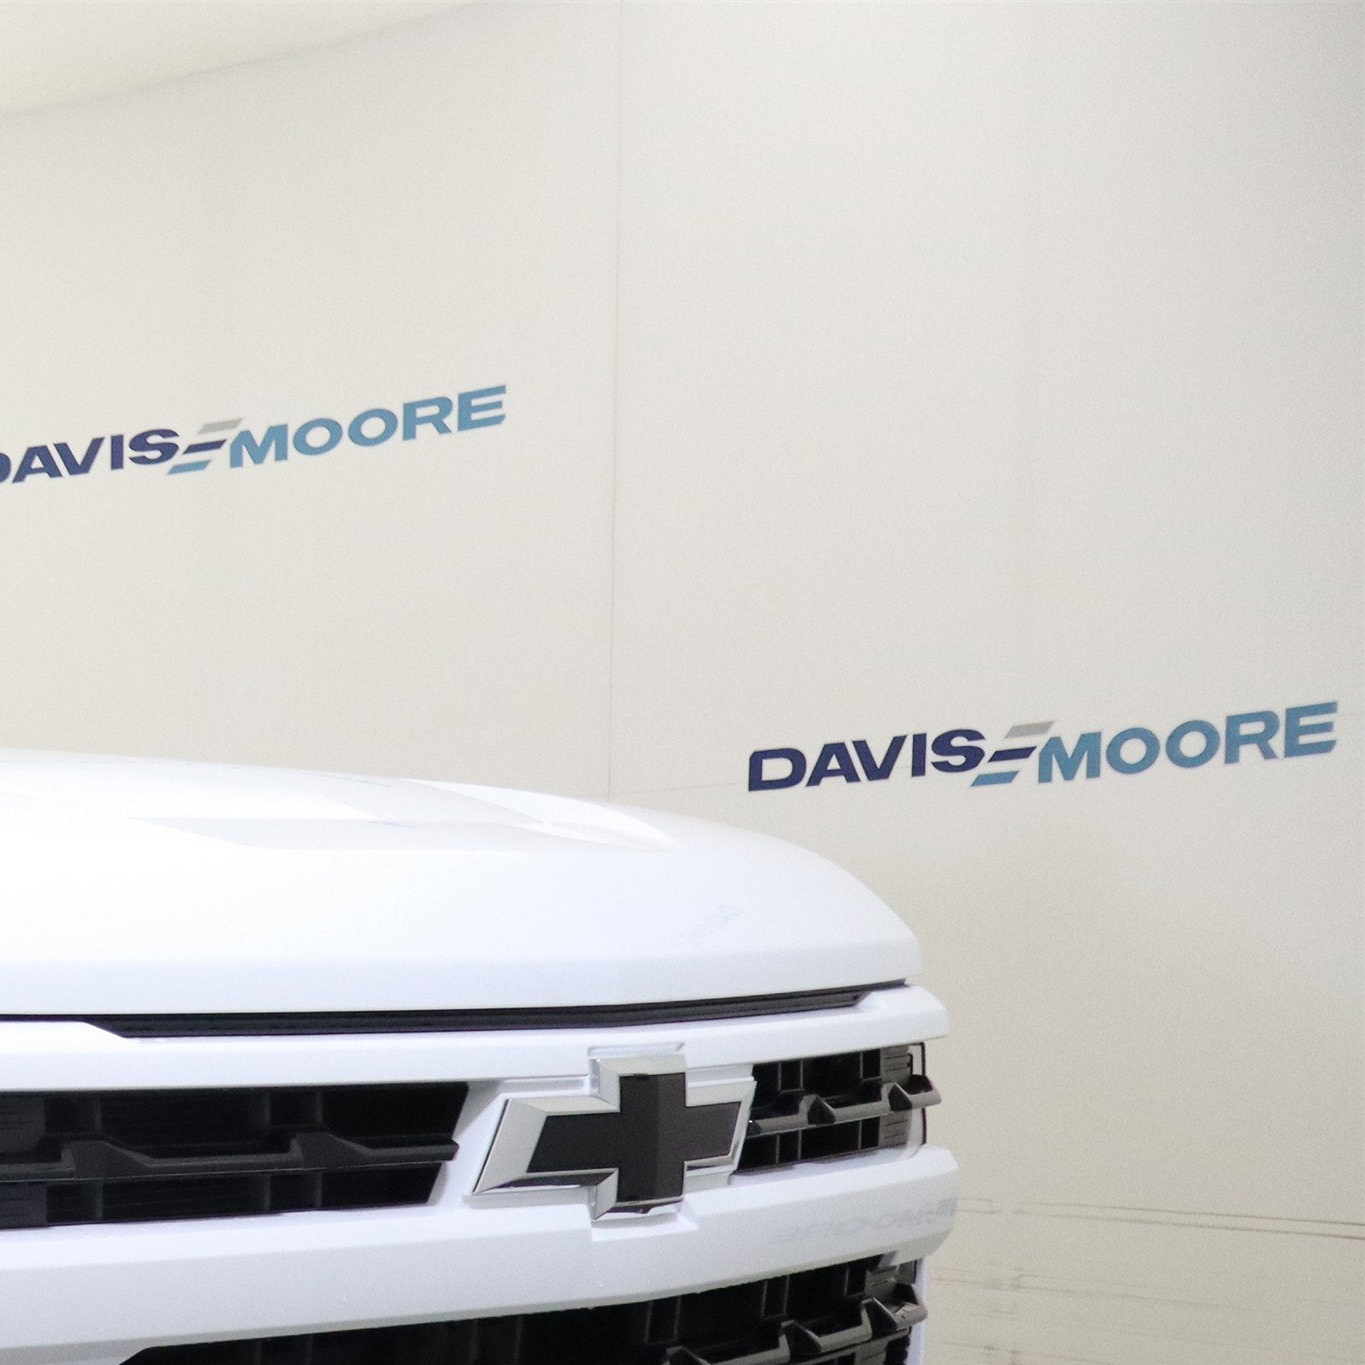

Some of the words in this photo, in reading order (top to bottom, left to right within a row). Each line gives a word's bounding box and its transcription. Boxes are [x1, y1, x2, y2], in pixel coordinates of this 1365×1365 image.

[230, 384, 508, 469] MOORE
[748, 728, 986, 792] DAVIS
[1038, 701, 1338, 784] MOORE
